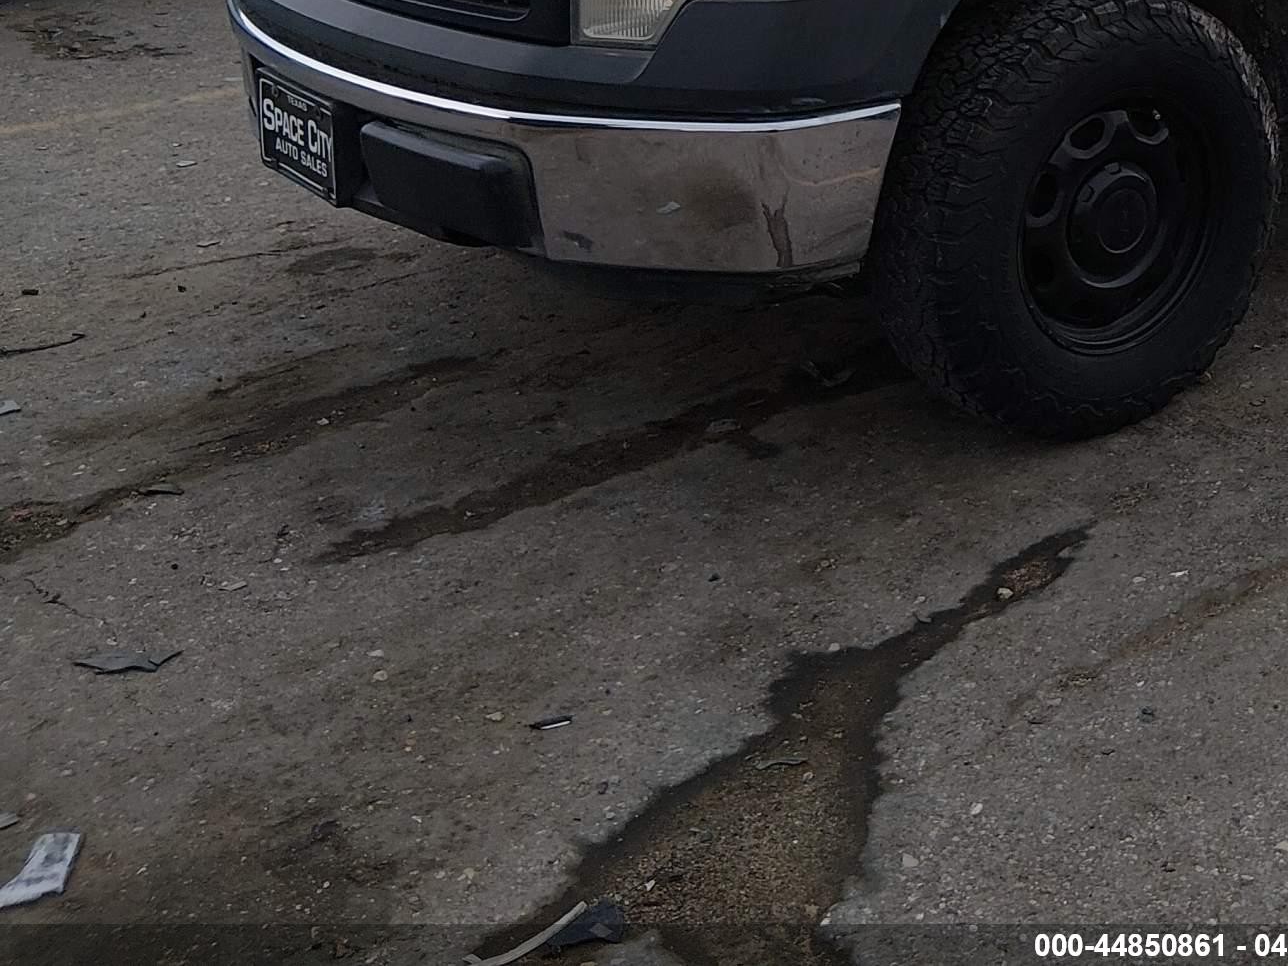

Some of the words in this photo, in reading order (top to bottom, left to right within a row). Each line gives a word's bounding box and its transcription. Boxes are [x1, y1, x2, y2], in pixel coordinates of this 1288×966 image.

[263, 98, 305, 146] SPACE
[307, 119, 332, 163] CITY
[275, 137, 299, 160] AUTO
[300, 150, 328, 177] SALES
